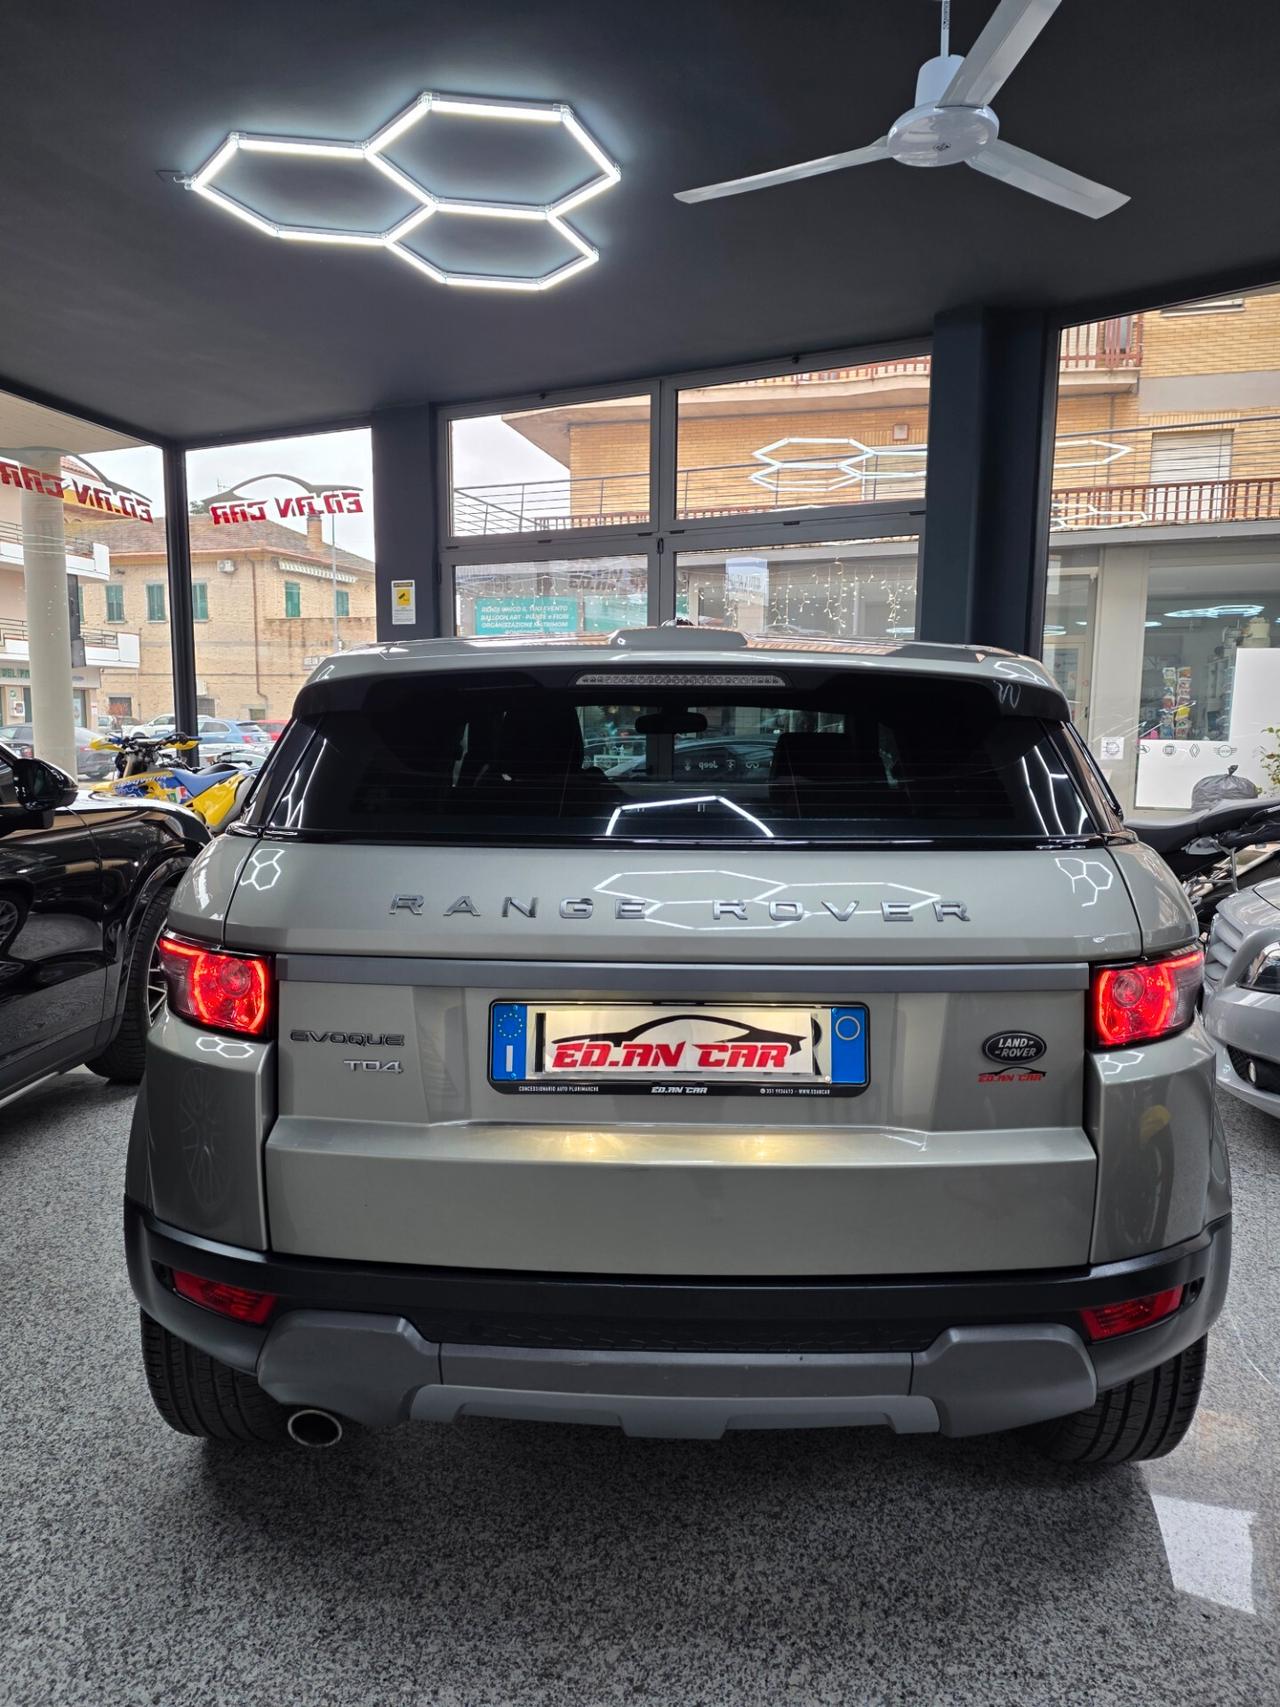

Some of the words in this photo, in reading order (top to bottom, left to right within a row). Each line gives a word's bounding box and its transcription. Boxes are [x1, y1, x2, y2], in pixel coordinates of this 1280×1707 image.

[389, 894, 647, 919] RANGE
[713, 900, 971, 922] ROVER
[290, 1029, 405, 1047] EVOQUE
[998, 1038, 1028, 1048] LAND
[552, 1040, 686, 1068] ED.AN
[692, 1043, 789, 1068] CAR
[1001, 1048, 1037, 1058] ROVER
[343, 1059, 404, 1074] TD4
[651, 1086, 684, 1094] ED.AN
[685, 1086, 708, 1094] CAR
